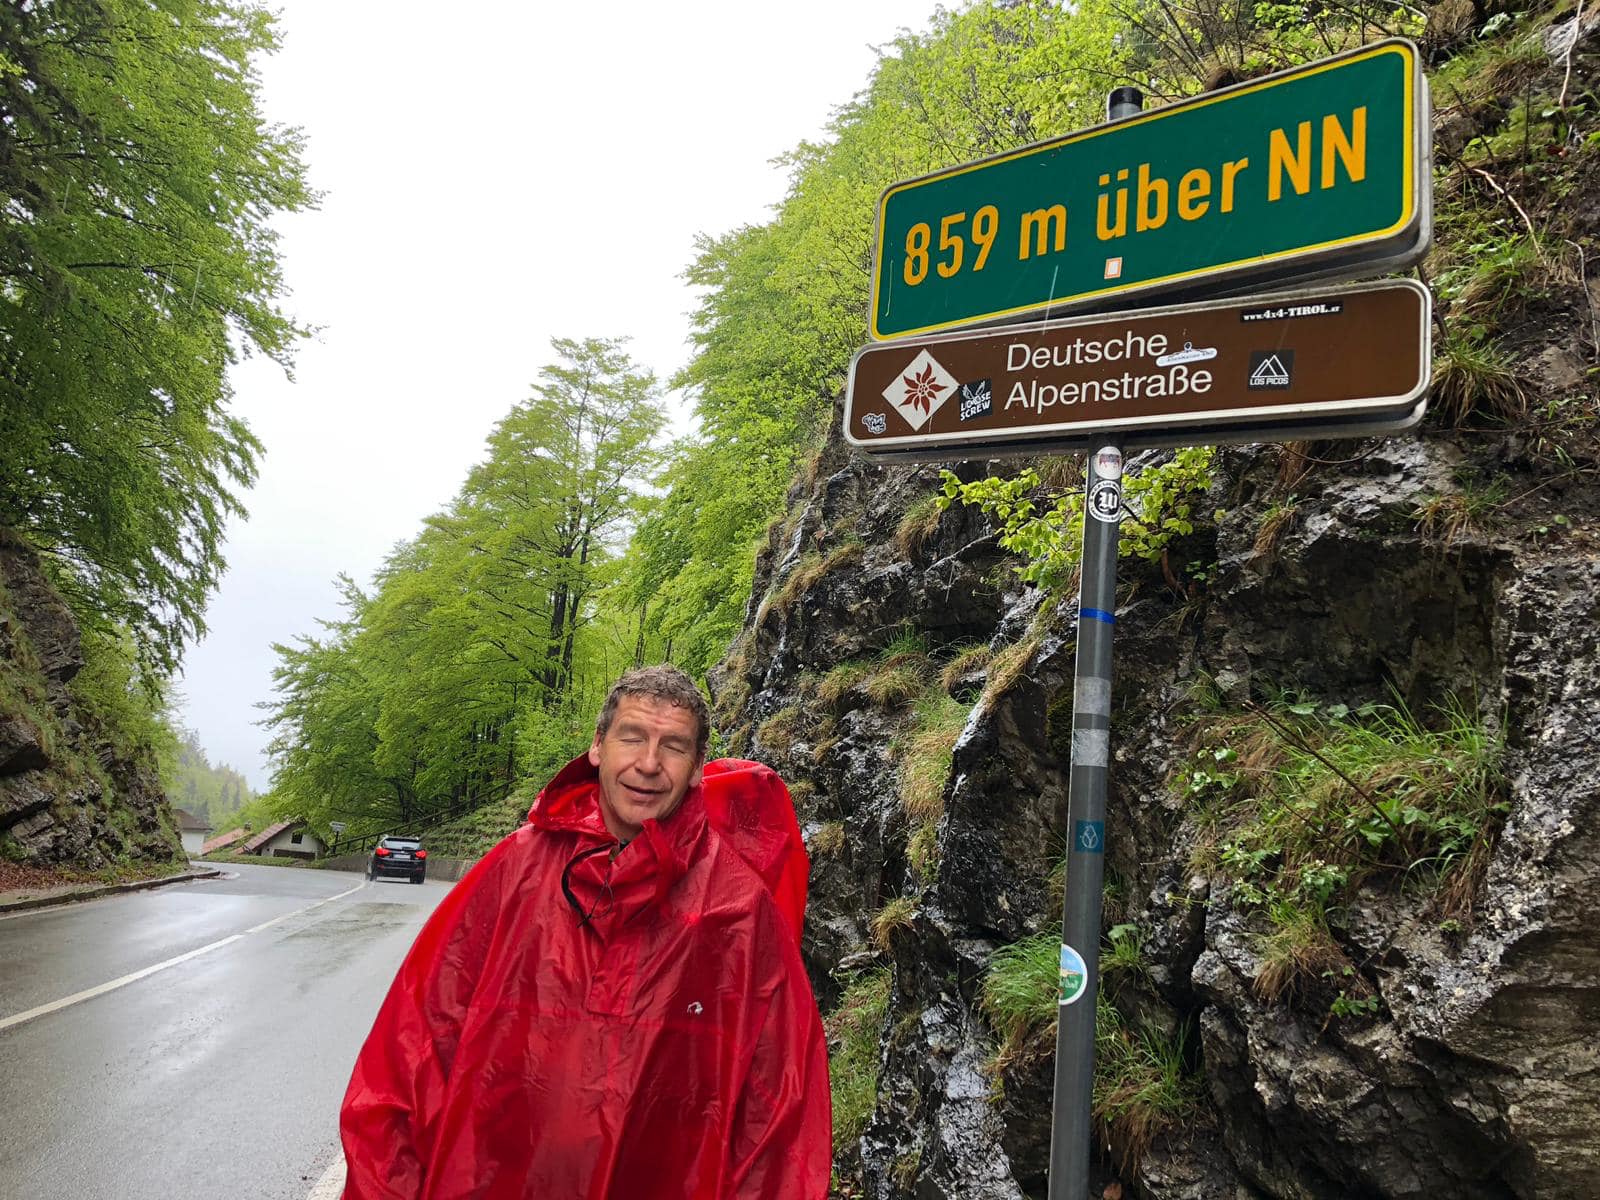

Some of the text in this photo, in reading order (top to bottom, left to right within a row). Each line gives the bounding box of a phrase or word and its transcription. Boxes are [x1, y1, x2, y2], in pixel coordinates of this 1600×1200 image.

[903, 107, 1367, 286] 859 m über NN
[1006, 331, 1168, 372] Deutsche
[1004, 365, 1213, 414] Alpenstraße
[1249, 377, 1289, 386] LOS PICOS
[960, 391, 991, 412] LOOSE
[960, 400, 991, 422] SCREW
